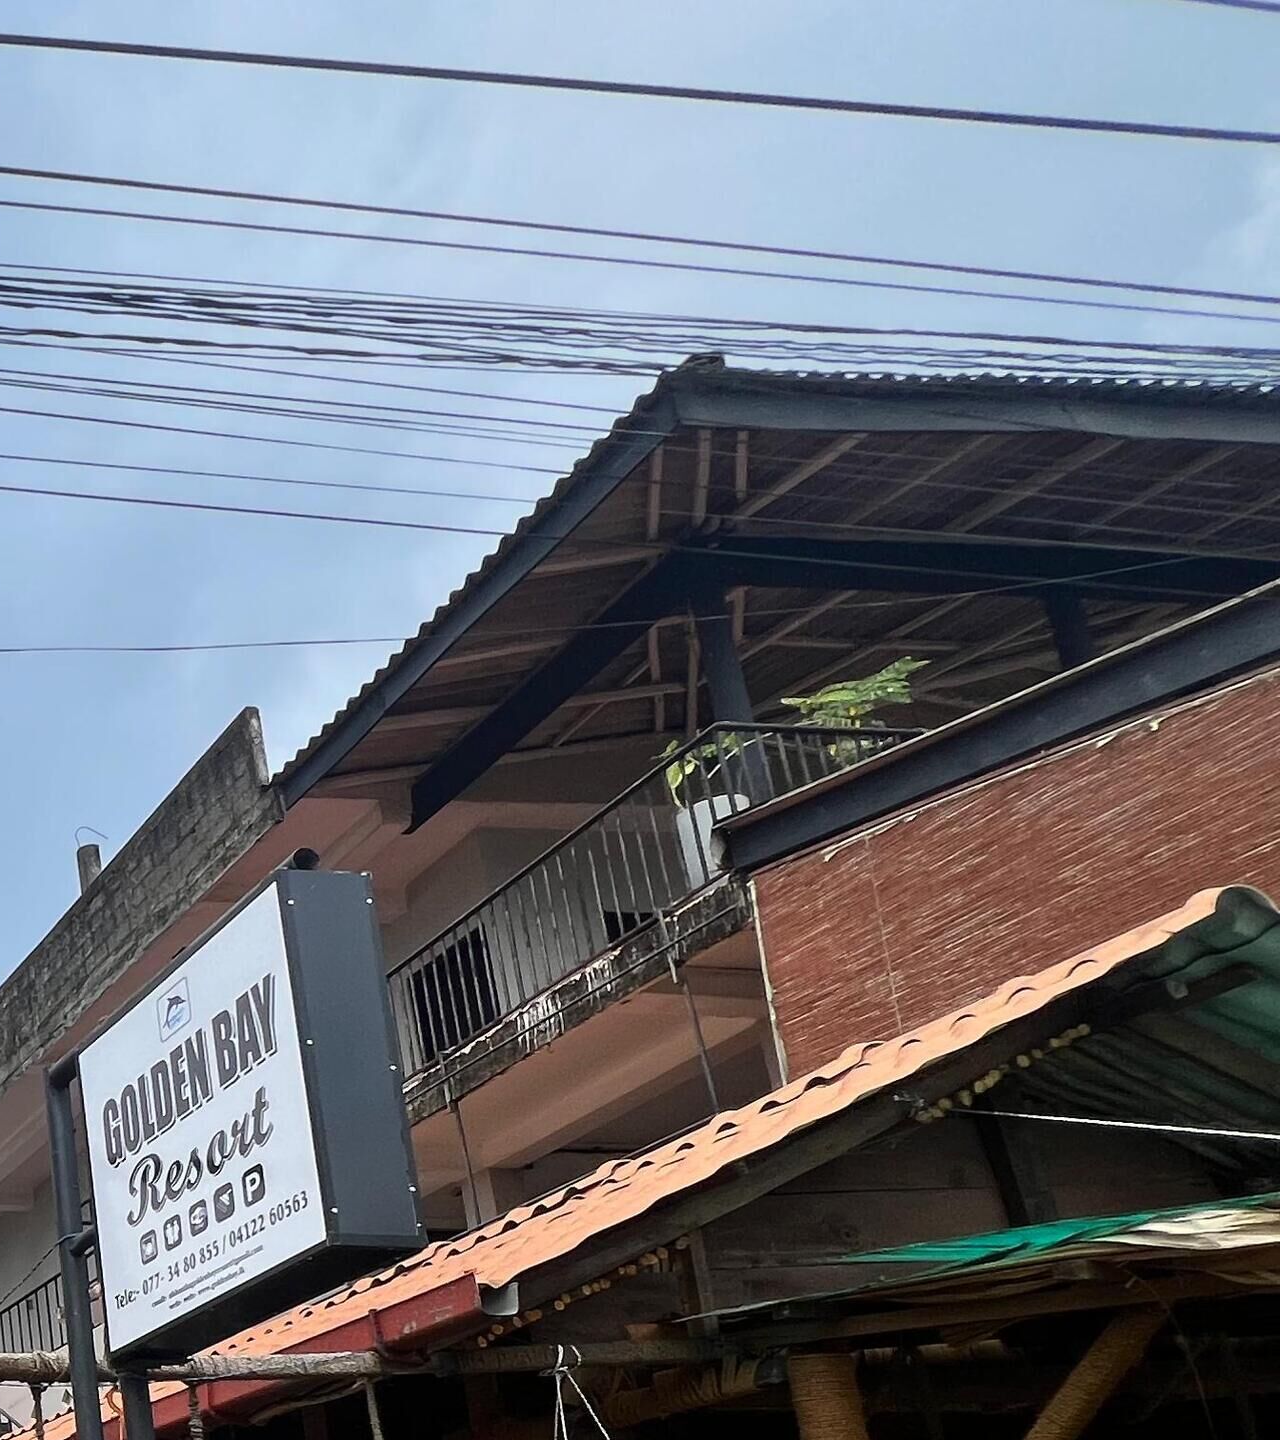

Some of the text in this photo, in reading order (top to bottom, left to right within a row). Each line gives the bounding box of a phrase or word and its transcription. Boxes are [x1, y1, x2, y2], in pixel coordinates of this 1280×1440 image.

[103, 973, 278, 1168] GOLDEN BAY
[127, 1086, 274, 1227] Resort
[167, 1261, 181, 1283] 34
[183, 1253, 197, 1273] 80
[199, 1240, 220, 1269] 855
[228, 1214, 266, 1248] 04122
